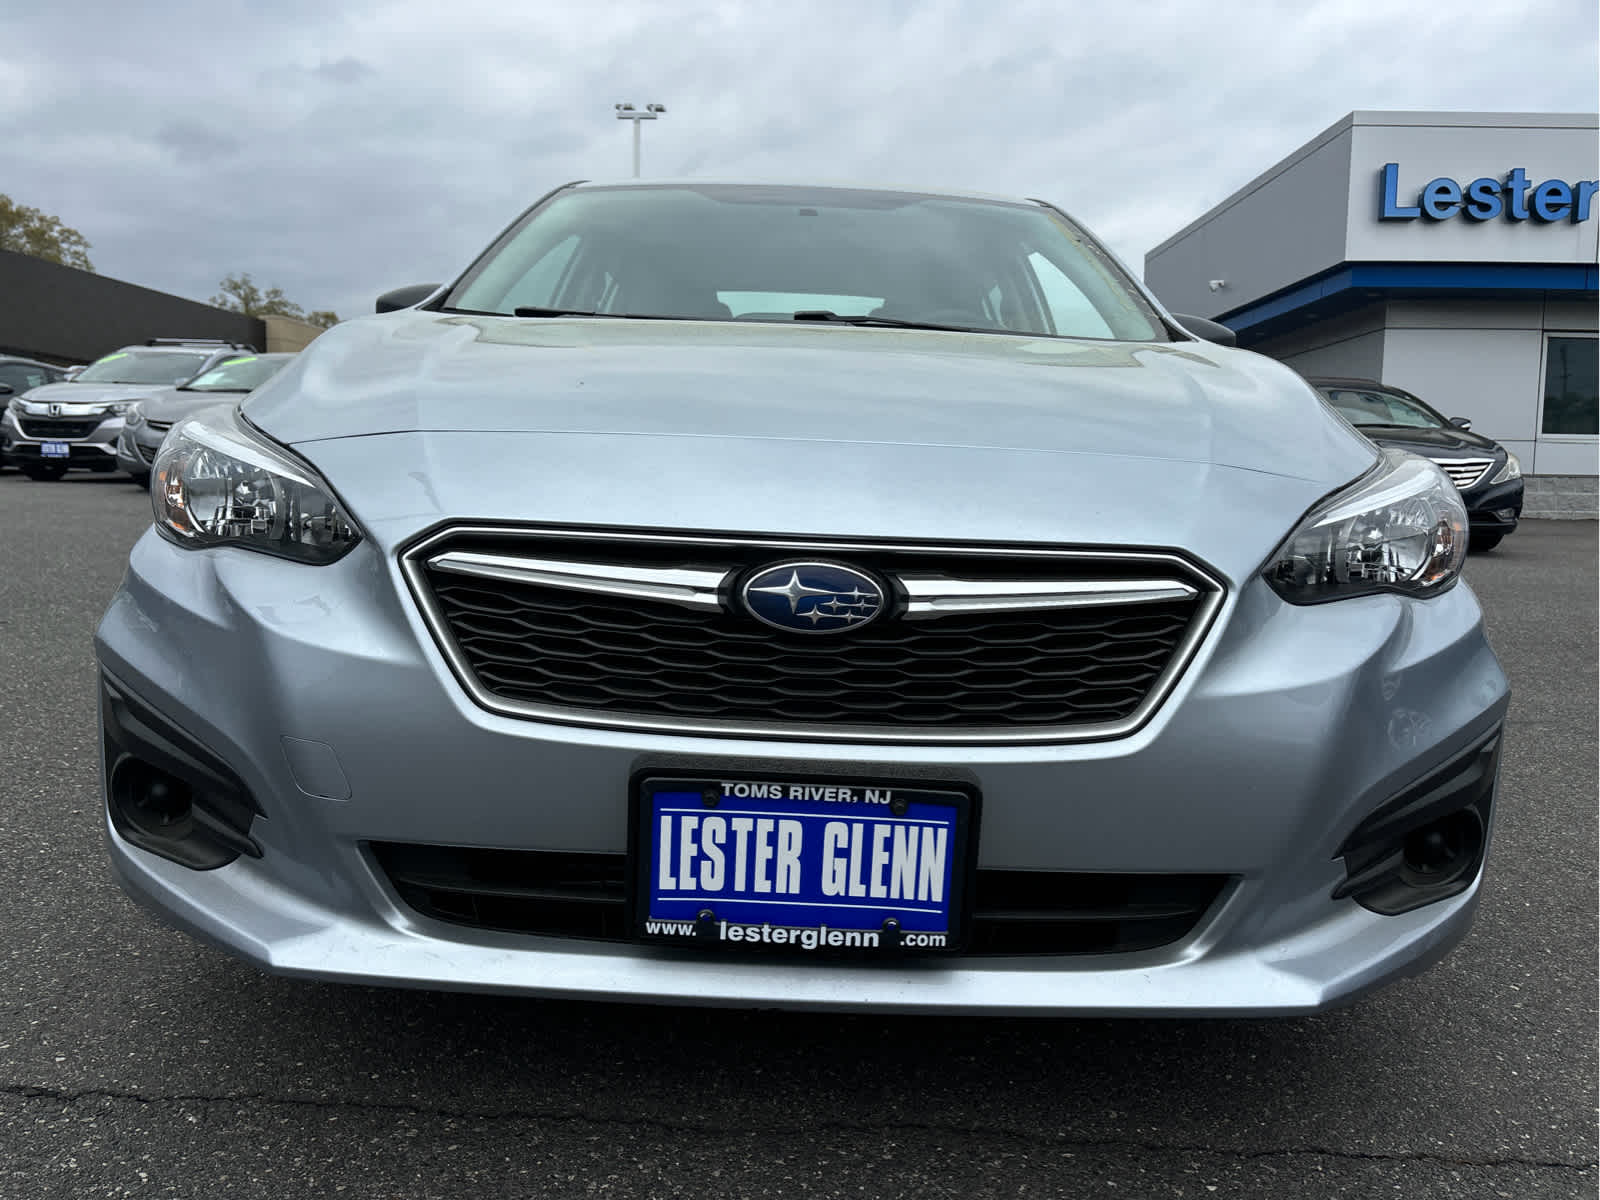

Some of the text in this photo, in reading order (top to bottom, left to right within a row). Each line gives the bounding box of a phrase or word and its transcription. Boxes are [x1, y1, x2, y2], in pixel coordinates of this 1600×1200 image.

[1380, 163, 1599, 222] Lester
[721, 783, 892, 805] TOMS RIVER, NJ
[658, 815, 948, 903] LESTER GLENN
[645, 921, 947, 950] www. lesterglenn .com
